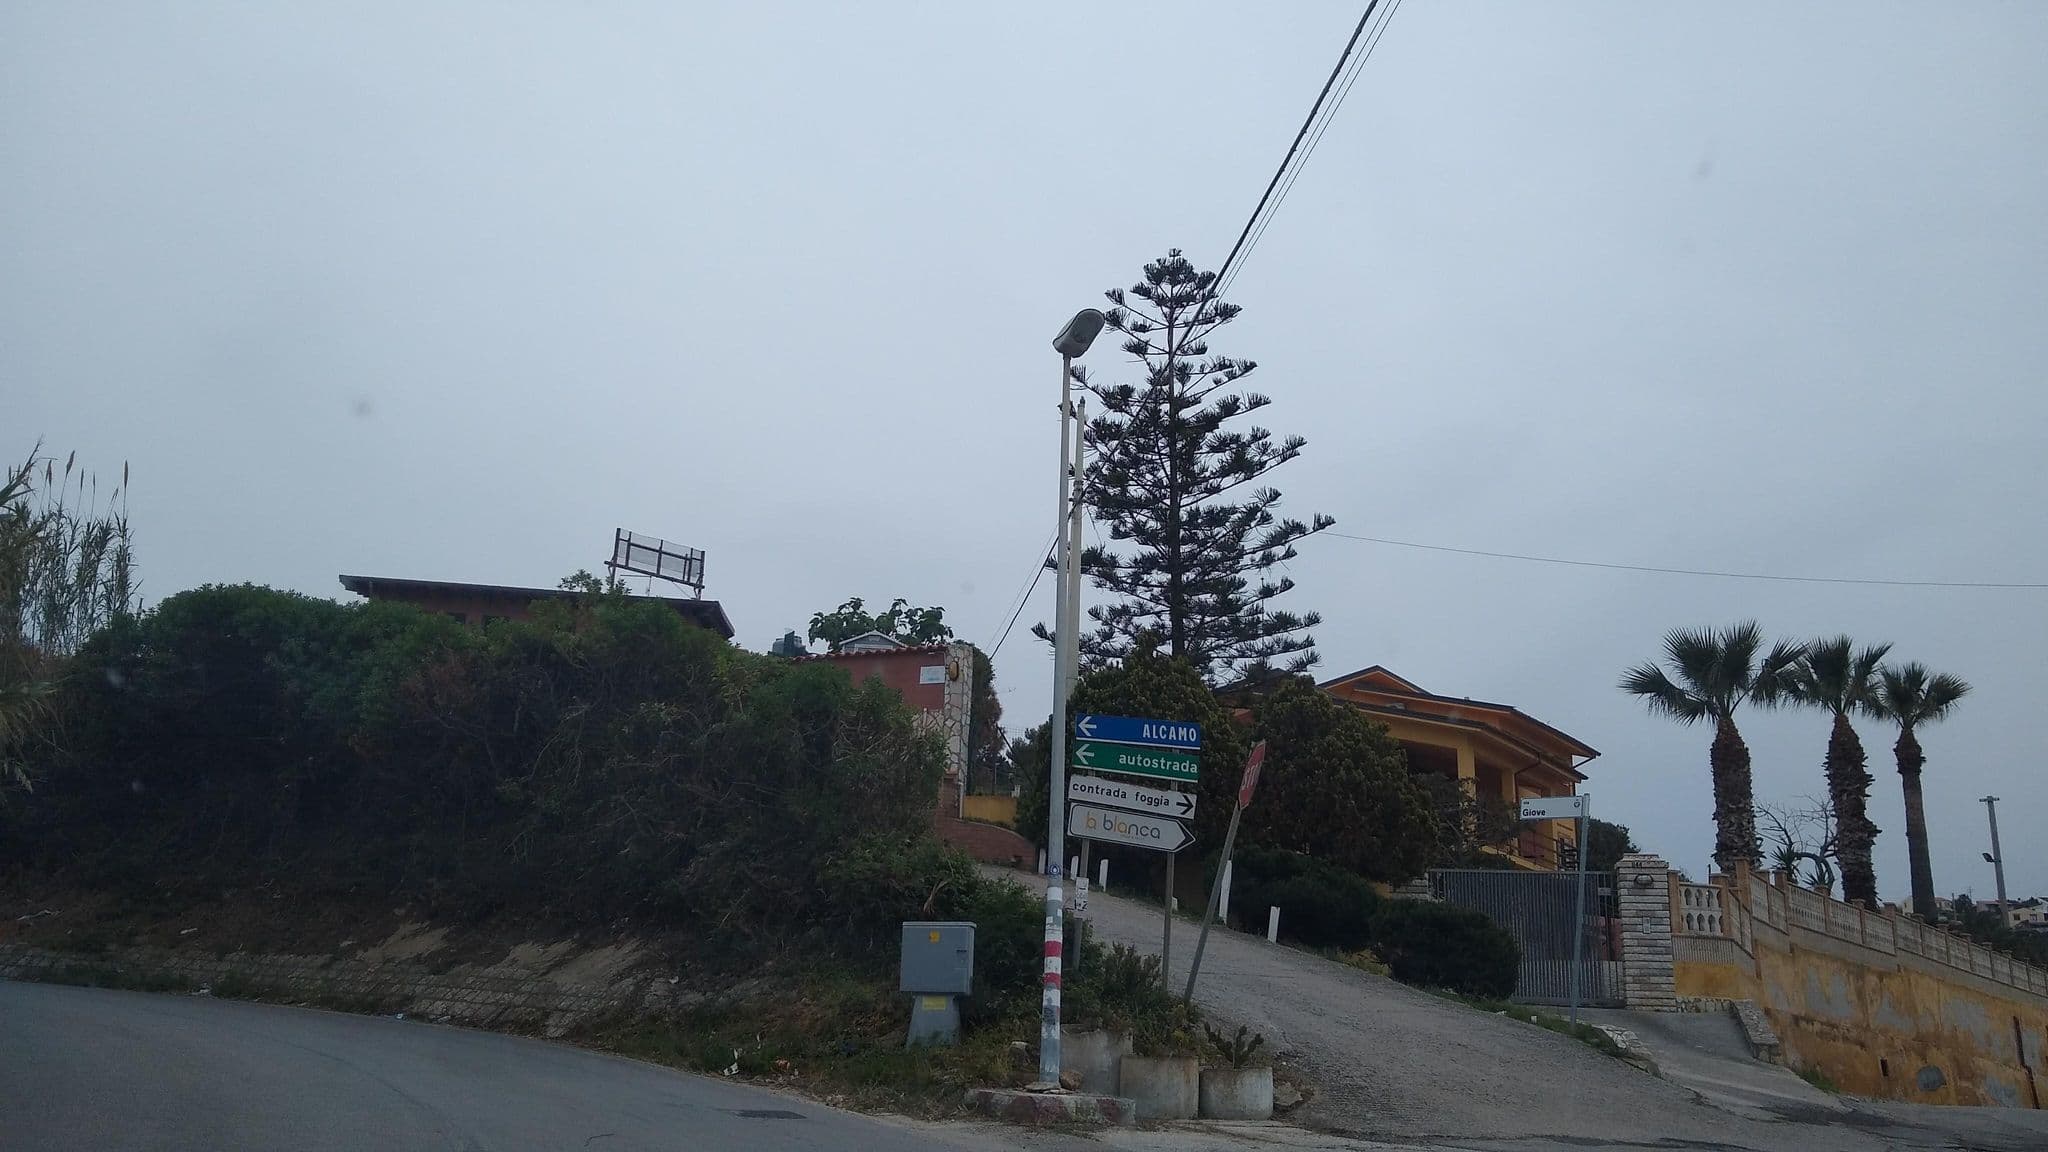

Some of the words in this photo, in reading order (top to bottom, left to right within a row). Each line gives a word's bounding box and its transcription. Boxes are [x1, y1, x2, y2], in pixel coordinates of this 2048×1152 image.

[1142, 723, 1197, 742] ALCAMO
[1118, 753, 1198, 774] autostrada
[1072, 782, 1127, 799] contrada
[1135, 791, 1170, 807] foggia
[1522, 808, 1546, 817] Giove
